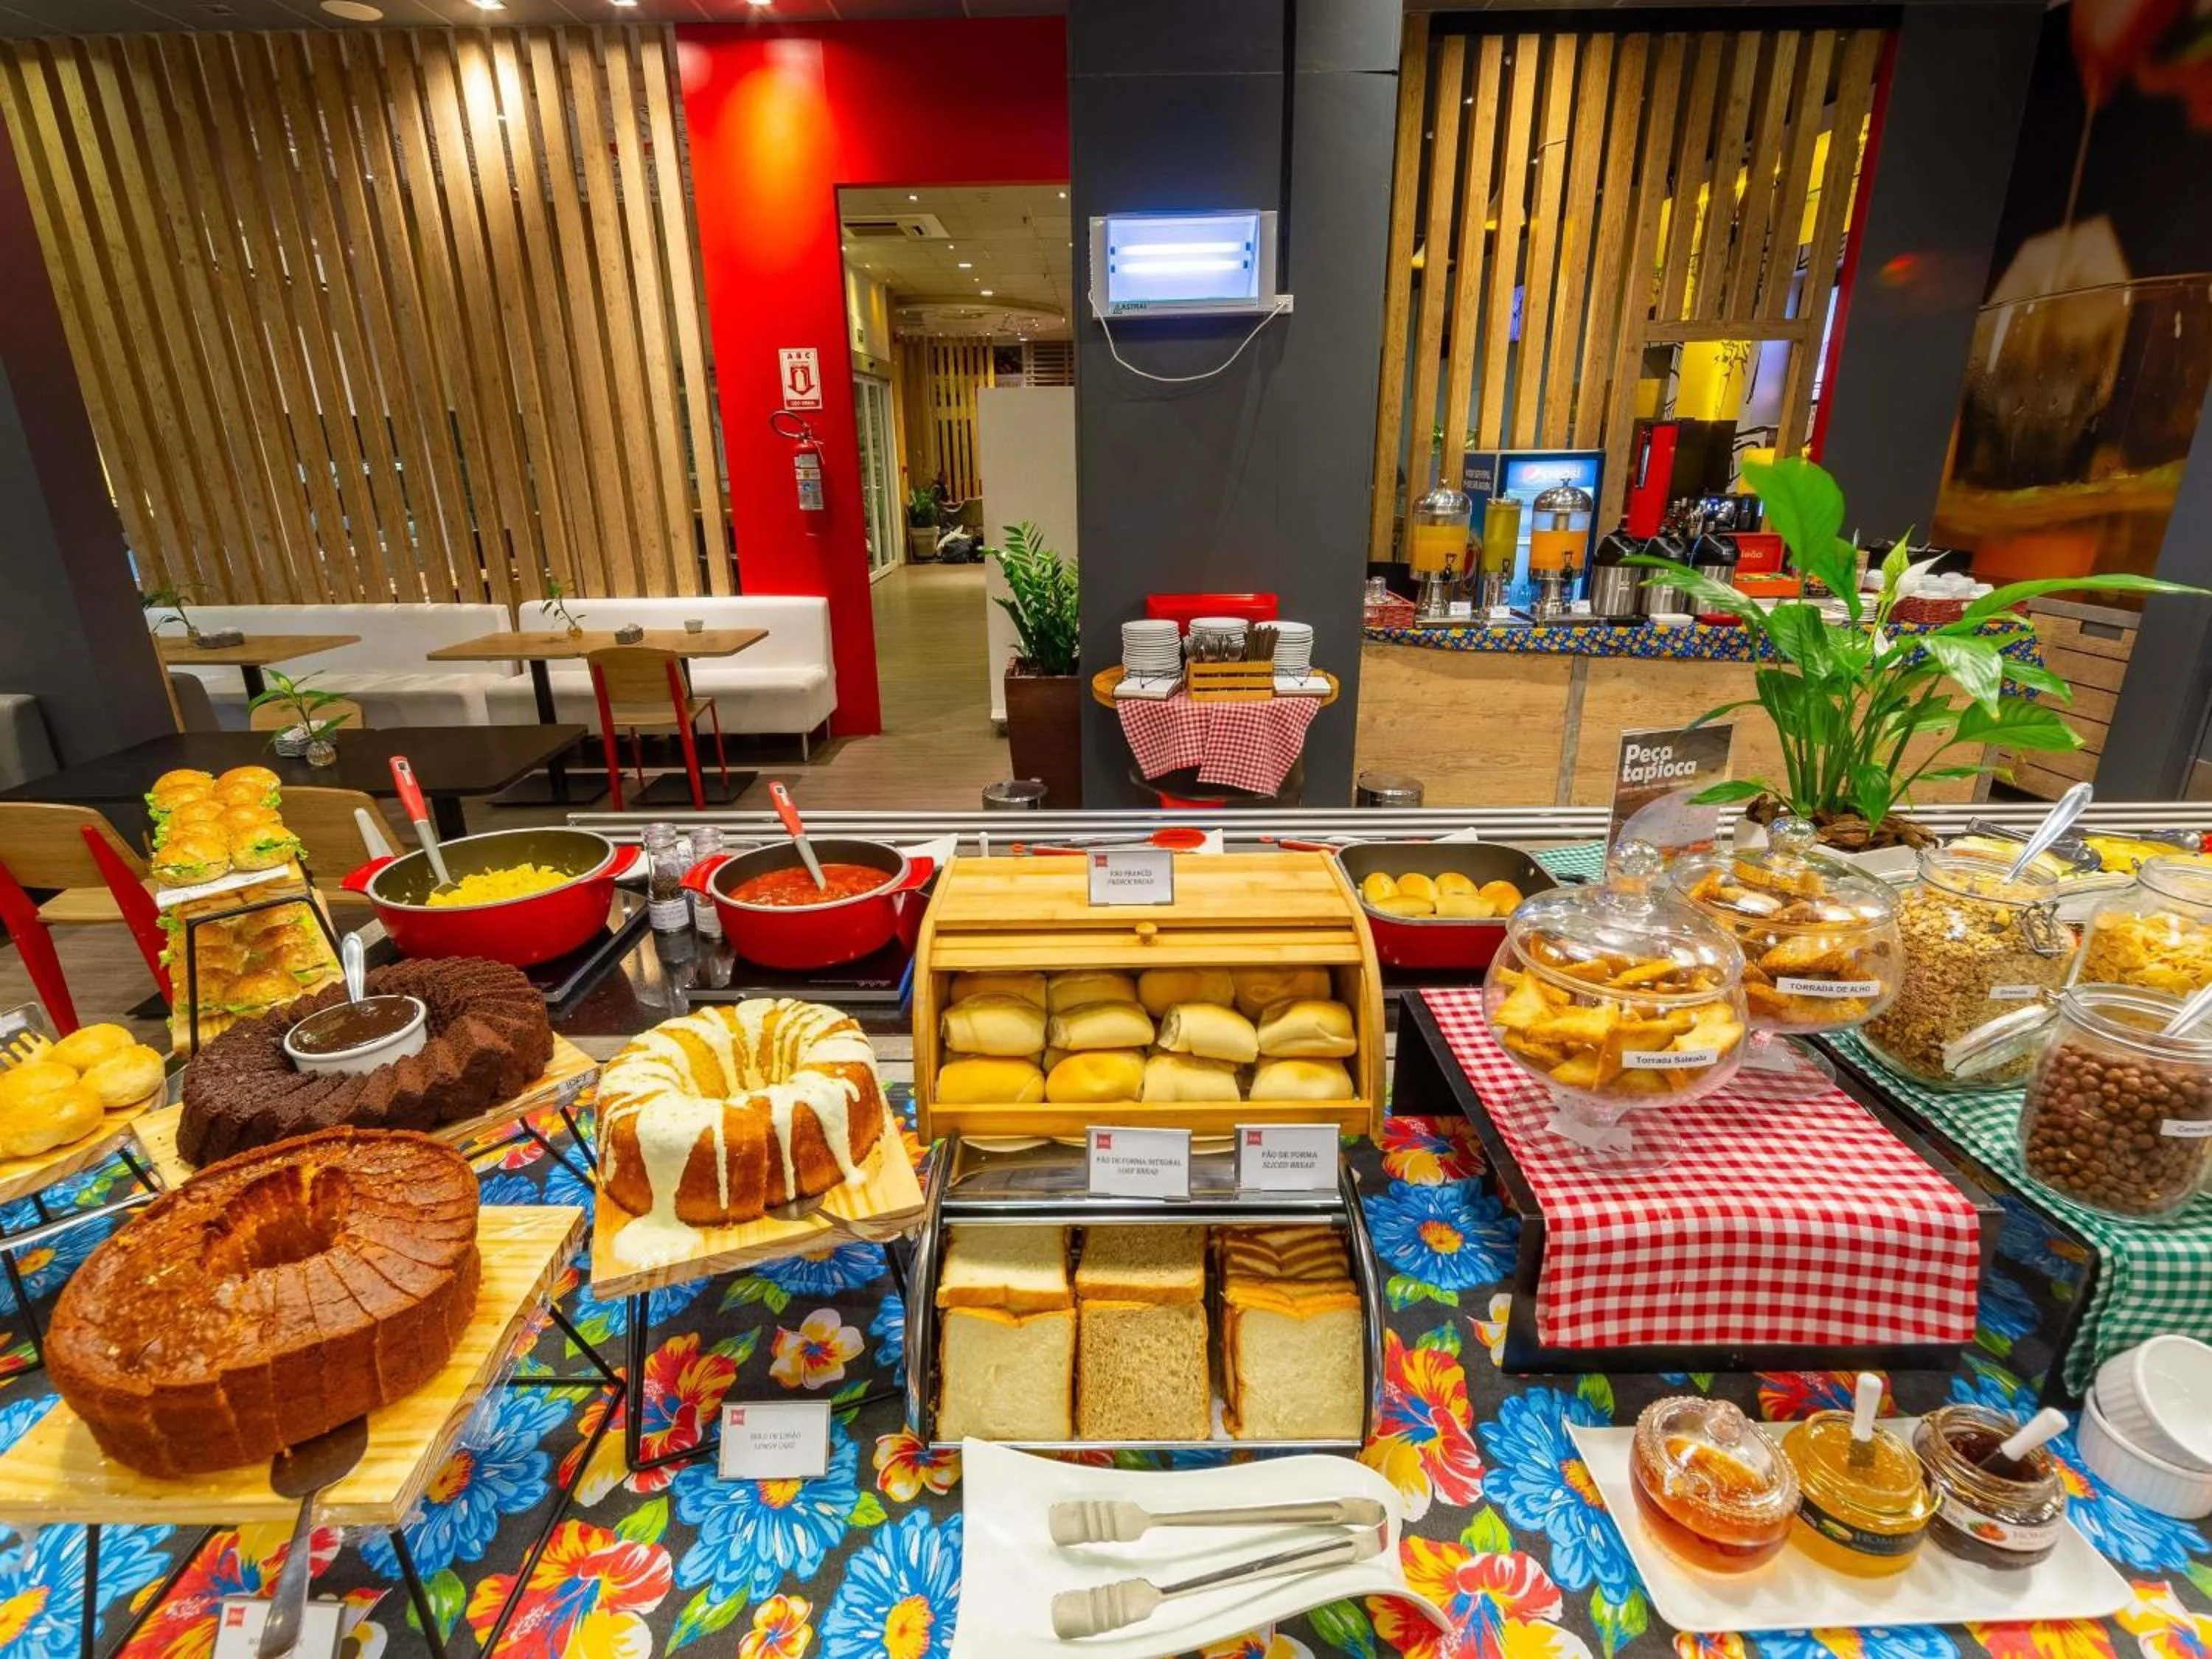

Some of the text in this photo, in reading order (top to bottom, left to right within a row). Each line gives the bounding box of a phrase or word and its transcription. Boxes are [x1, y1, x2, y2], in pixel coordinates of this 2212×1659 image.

[1624, 744, 1673, 765] Peça
[1622, 760, 1697, 784] tapioca
[1790, 983, 1834, 992] TORRADA
[1636, 1055, 1672, 1064] Torrada
[1262, 1150, 1276, 1158] PÃO
